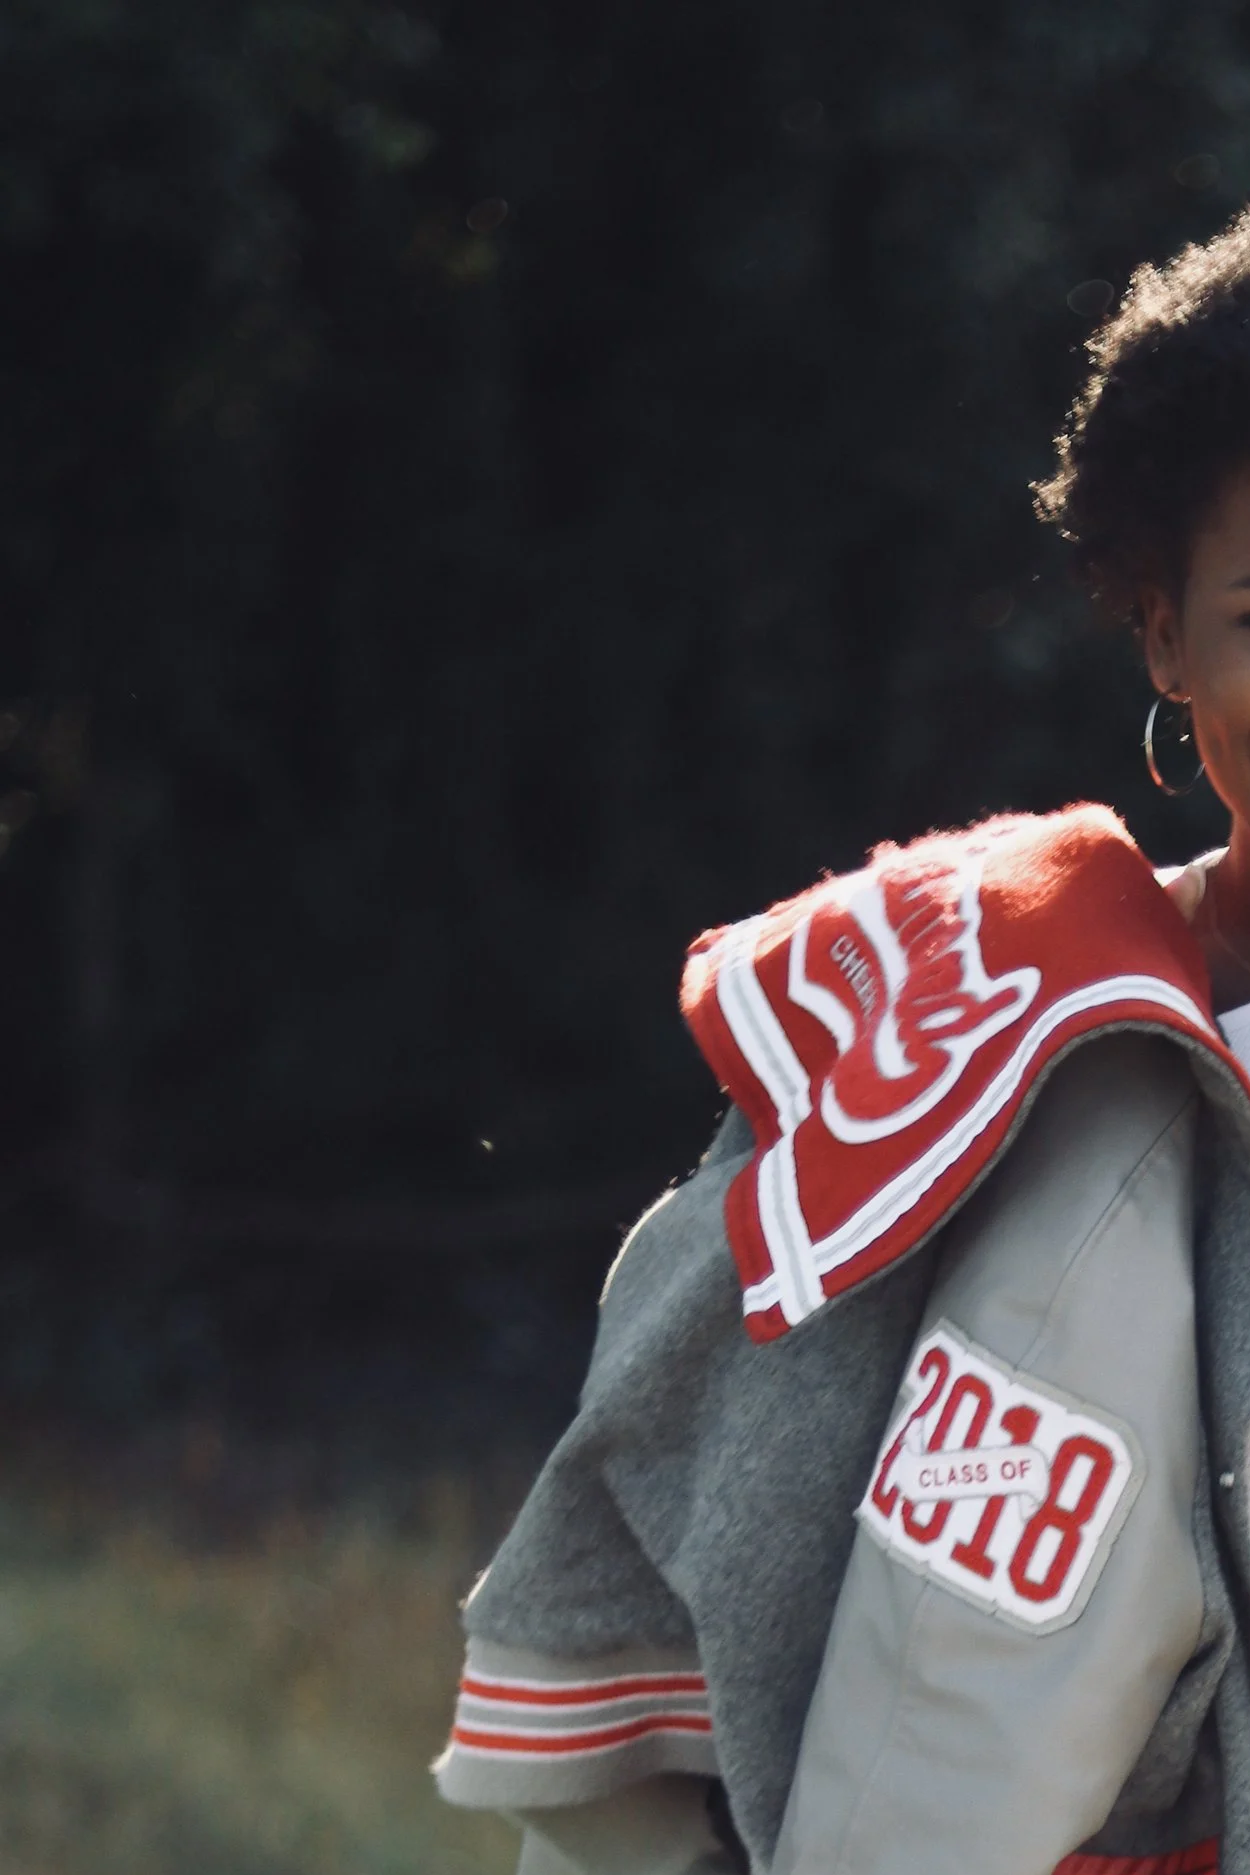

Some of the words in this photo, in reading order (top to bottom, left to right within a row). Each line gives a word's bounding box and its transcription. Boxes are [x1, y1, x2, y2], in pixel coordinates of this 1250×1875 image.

[872, 1347, 1114, 1604] 2018
[919, 1463, 988, 1487] CLASS
[1001, 1460, 1031, 1480] OF
